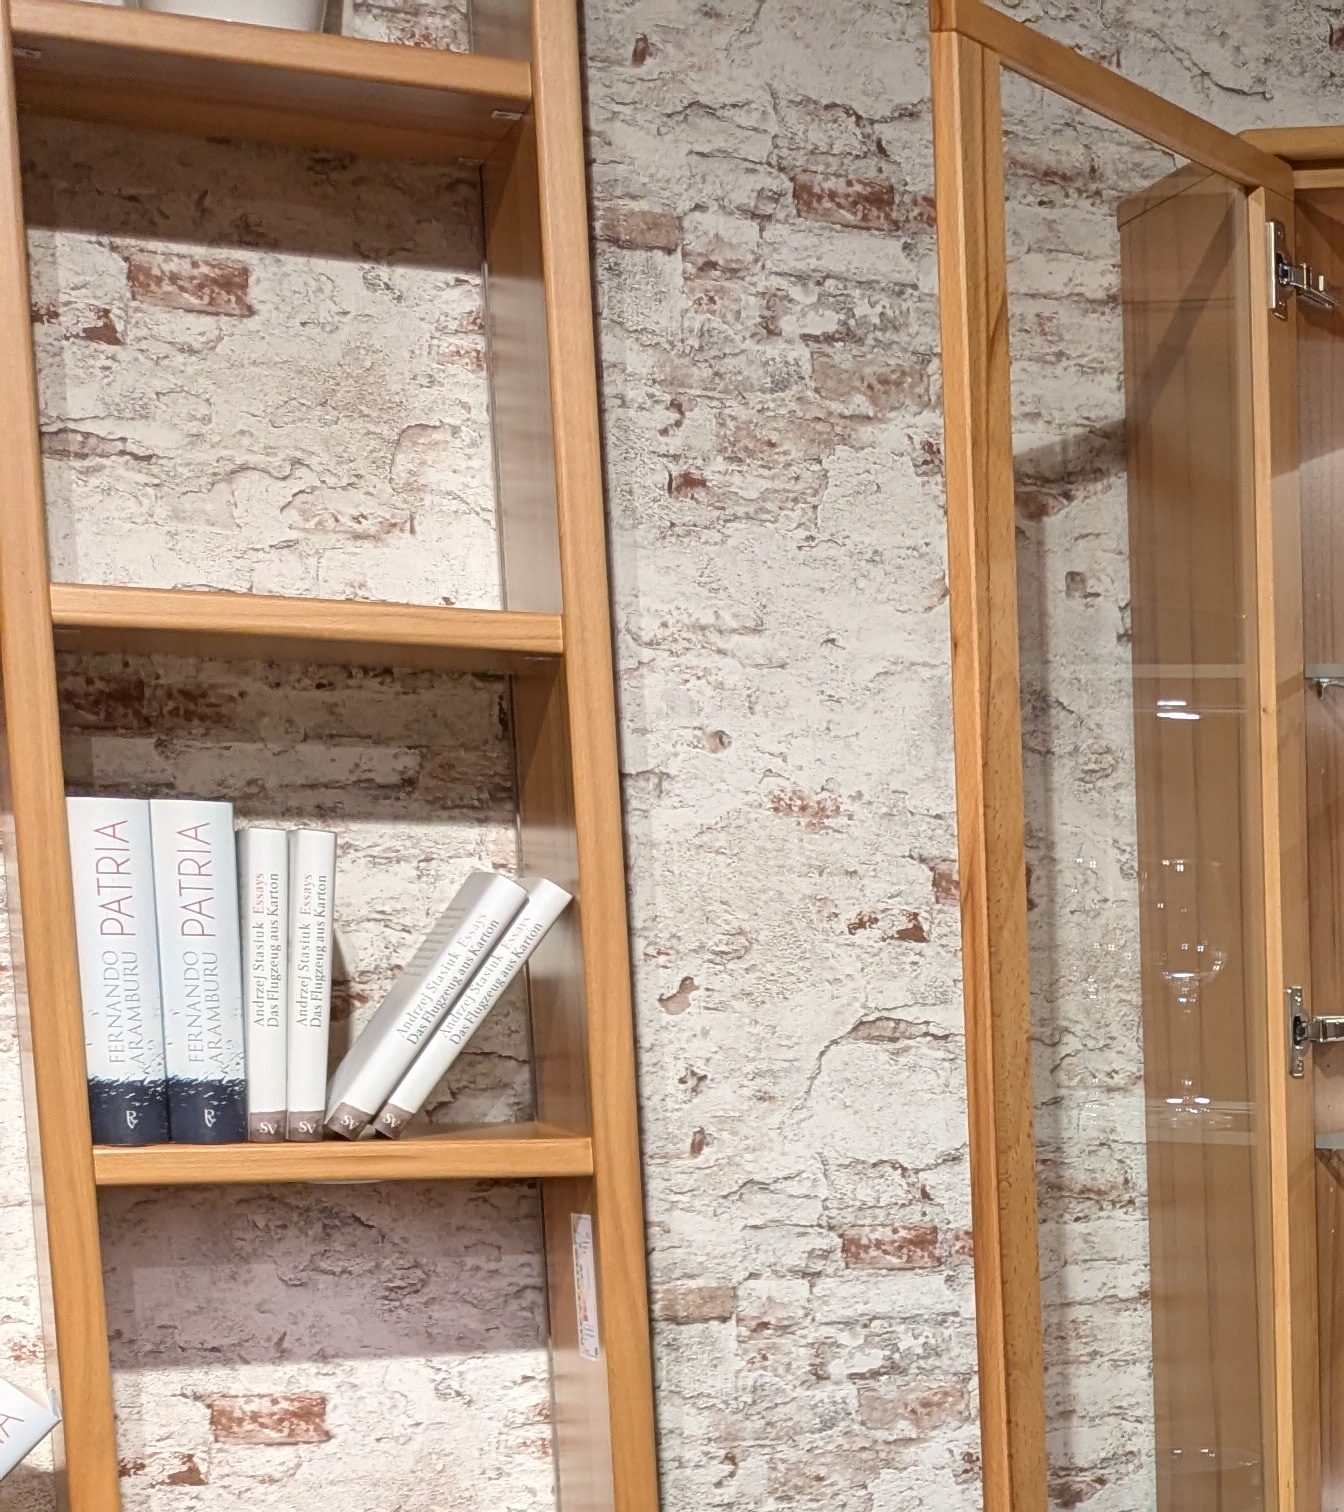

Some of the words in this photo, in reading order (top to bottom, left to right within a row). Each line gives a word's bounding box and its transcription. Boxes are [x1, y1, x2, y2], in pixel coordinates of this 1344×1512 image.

[93, 820, 136, 936] PATRIA
[176, 822, 217, 937] PATRIA
[253, 872, 268, 915] Essays
[267, 873, 279, 917] Karton
[300, 874, 315, 915] Essays
[314, 875, 327, 918] Karton
[252, 922, 265, 972] Stasiuk
[270, 920, 279, 941] aus
[298, 922, 311, 972] Stasiuk
[315, 921, 325, 942] aus
[267, 944, 281, 1001] Flugzeug
[310, 945, 326, 1001] Flugzeug
[396, 992, 434, 1038] Andrzej
[425, 951, 462, 994] Stasiuk
[406, 1021, 428, 1045] Das
[421, 973, 462, 1024] Flugzeug
[458, 956, 474, 976] aus
[467, 919, 500, 957] Karton
[439, 994, 476, 1038] Andrzej
[469, 953, 504, 995] Stasiuk
[449, 1021, 470, 1045] Das
[464, 976, 506, 1025] Flugzeug
[501, 958, 517, 979] aus
[511, 922, 543, 958] Karton
[102, 950, 126, 1063] FERNANDO
[122, 951, 145, 1064] ARAMBURU
[183, 950, 205, 1063] FERNANDO
[202, 951, 224, 1064] ARAMBURU
[252, 975, 267, 1027] Andrzej
[267, 1004, 279, 1028] Das
[296, 975, 312, 1026] Andrzej
[310, 1004, 322, 1028] Das
[259, 1121, 277, 1135] SV
[298, 1121, 317, 1134] SV
[340, 1114, 359, 1130] SV
[382, 1113, 401, 1128] SV
